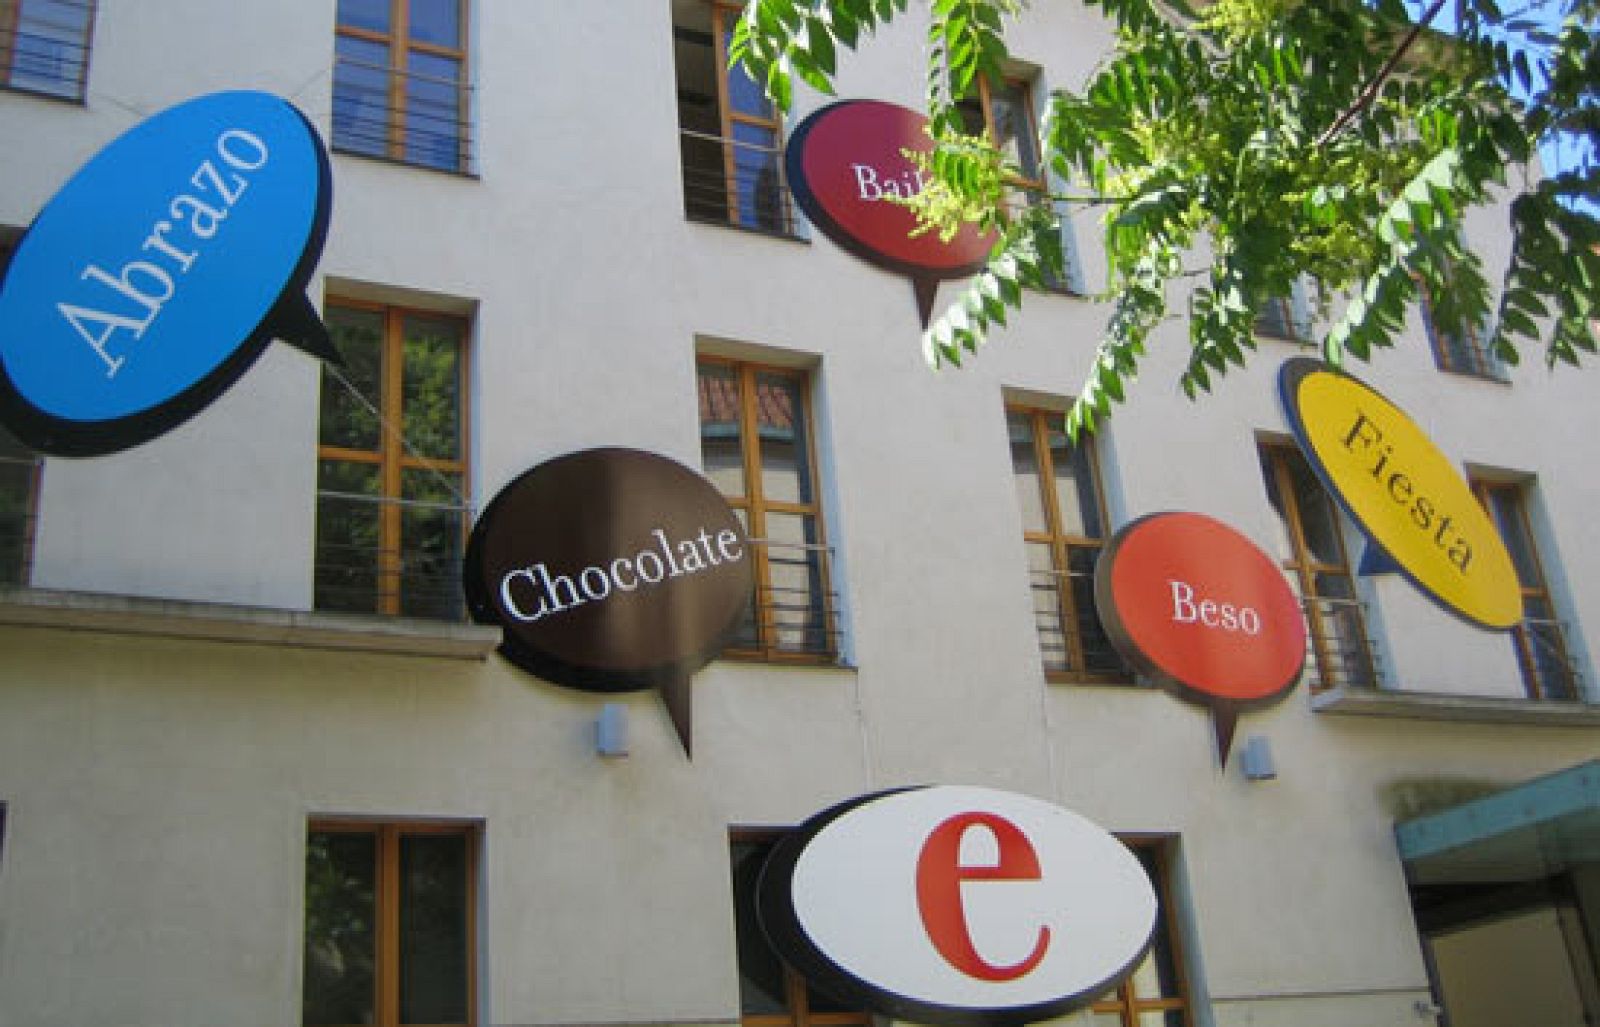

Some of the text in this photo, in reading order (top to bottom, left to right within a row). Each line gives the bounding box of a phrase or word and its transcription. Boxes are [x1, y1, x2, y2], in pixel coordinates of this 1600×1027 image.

[56, 128, 268, 379] Abrazo
[501, 506, 743, 621] Chocolate
[1340, 409, 1472, 576] Fiesta
[1167, 579, 1260, 635] Beso
[915, 811, 1051, 984] e
